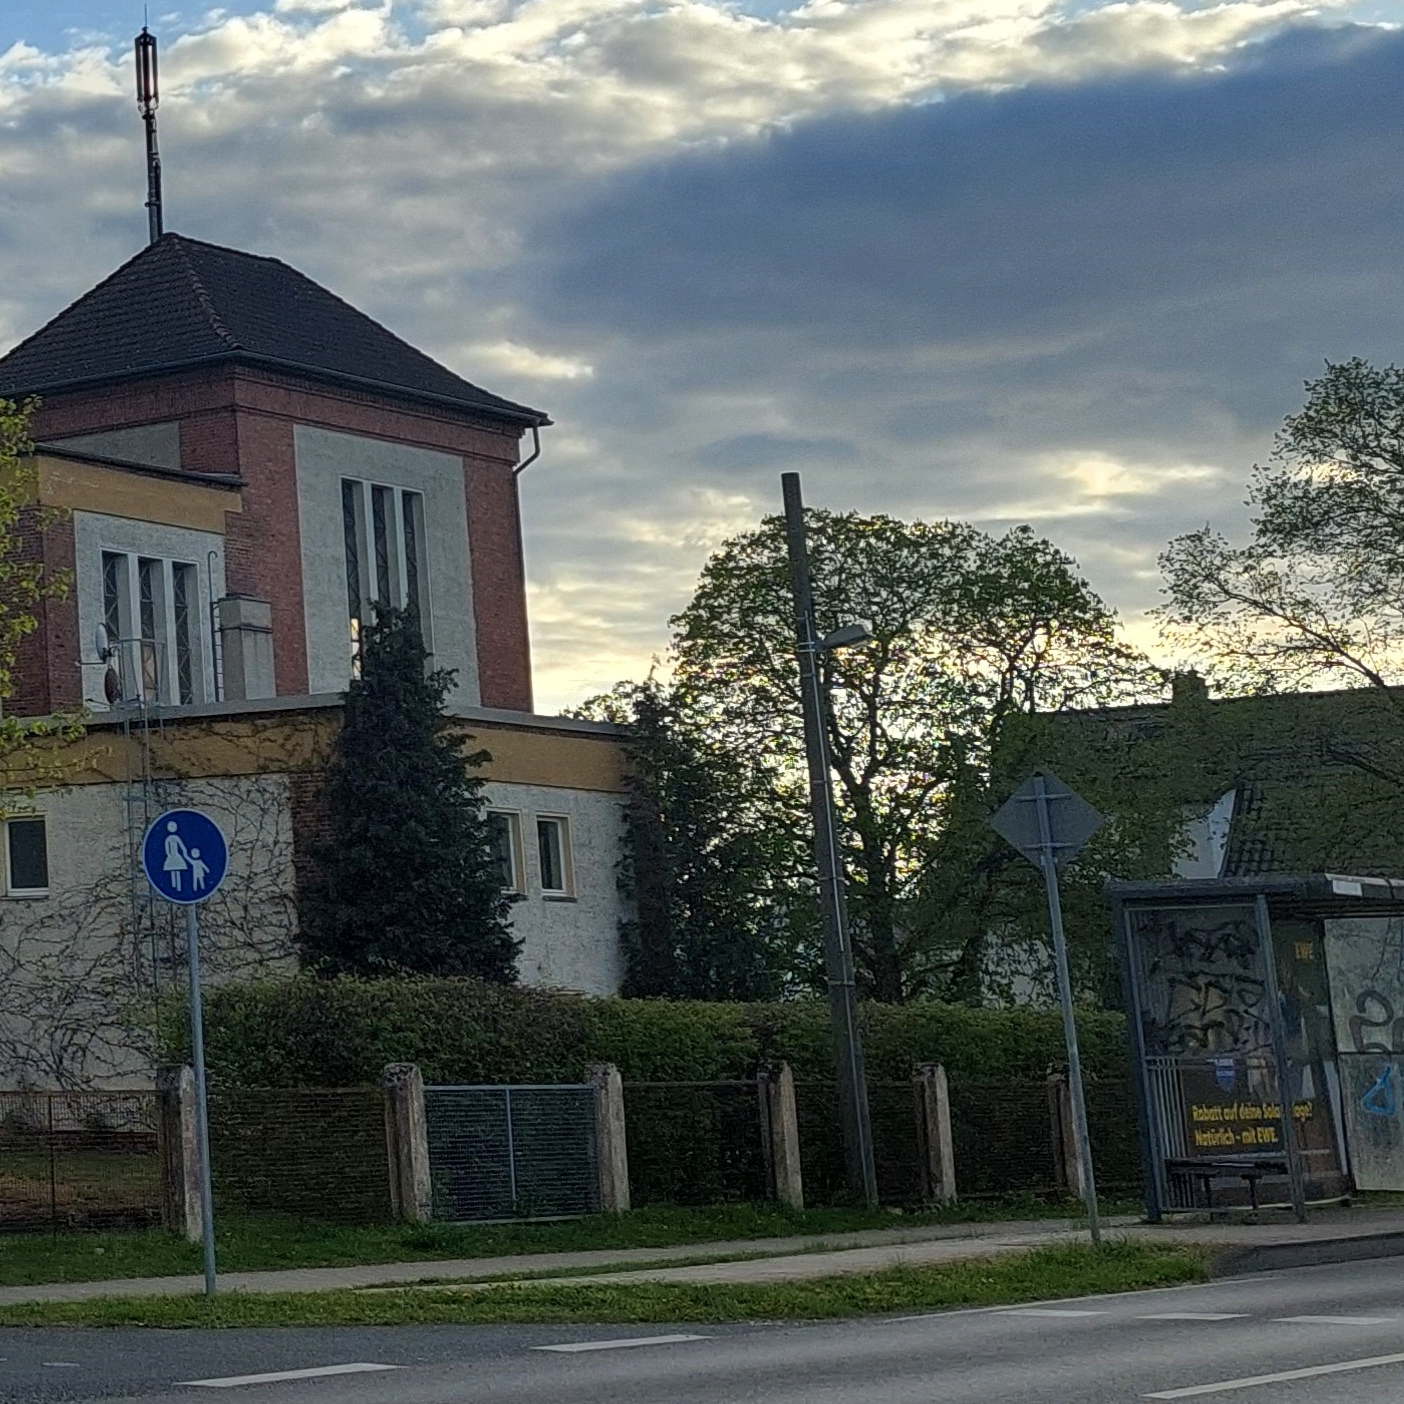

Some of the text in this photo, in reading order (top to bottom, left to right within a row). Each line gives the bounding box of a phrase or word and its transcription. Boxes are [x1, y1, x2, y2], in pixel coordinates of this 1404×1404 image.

[1192, 1103, 1223, 1121] Rabatt
[1223, 1101, 1238, 1119] auf
[1239, 1102, 1262, 1119] deine
[1194, 1126, 1235, 1147] Natürlich
[1242, 1126, 1257, 1144] mit
